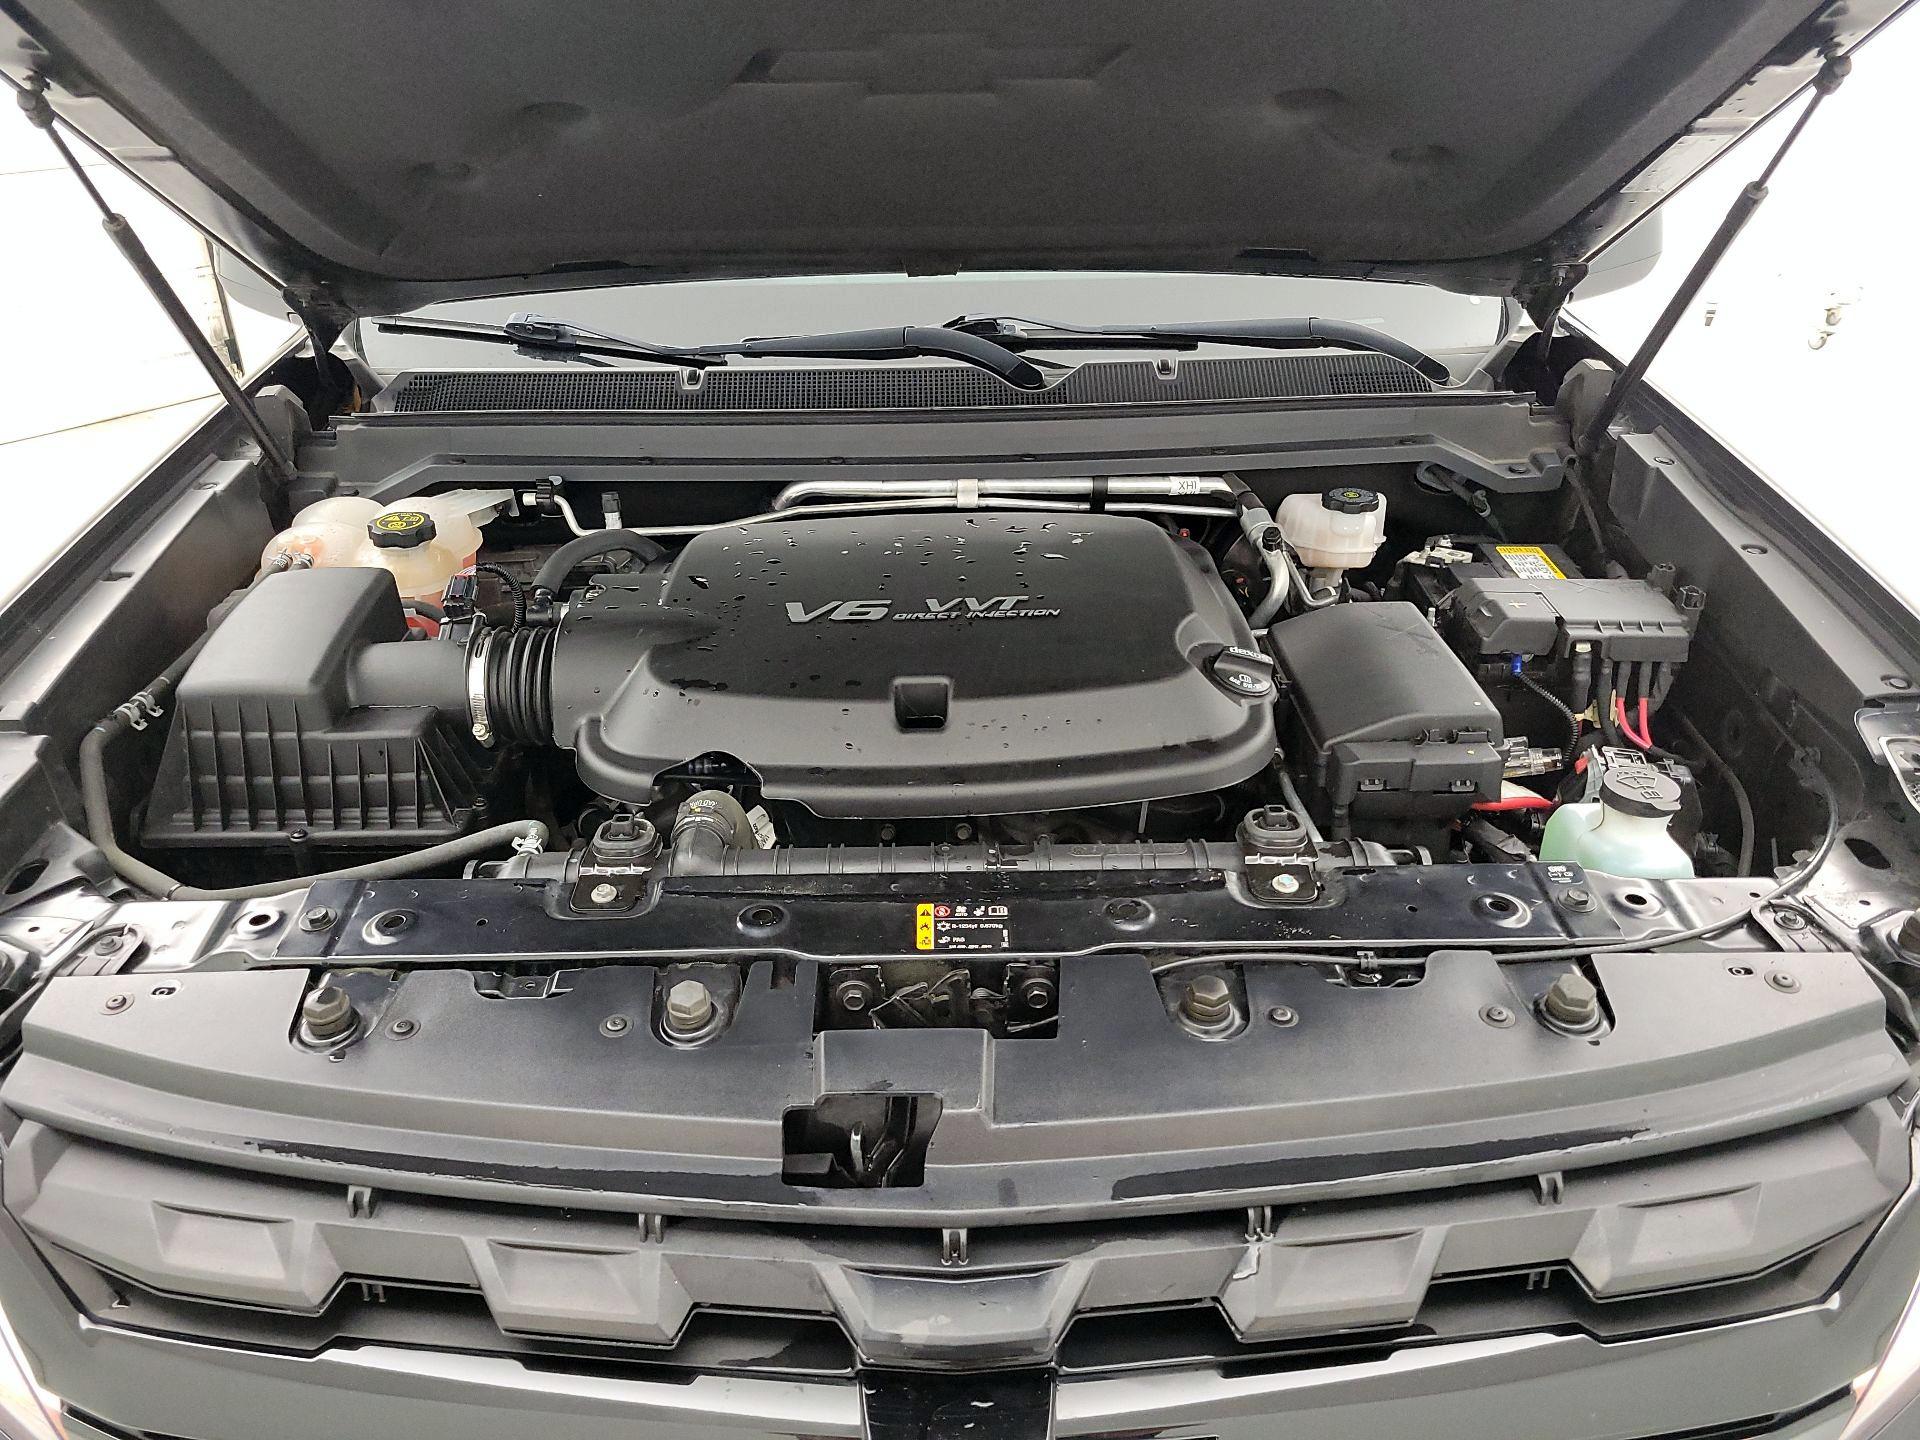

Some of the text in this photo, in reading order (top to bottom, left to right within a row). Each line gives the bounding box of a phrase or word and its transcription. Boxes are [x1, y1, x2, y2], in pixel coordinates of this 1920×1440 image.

[785, 599, 892, 623] V6
[925, 595, 1029, 612] VVT
[892, 608, 1061, 621] DIRECT INJECTION
